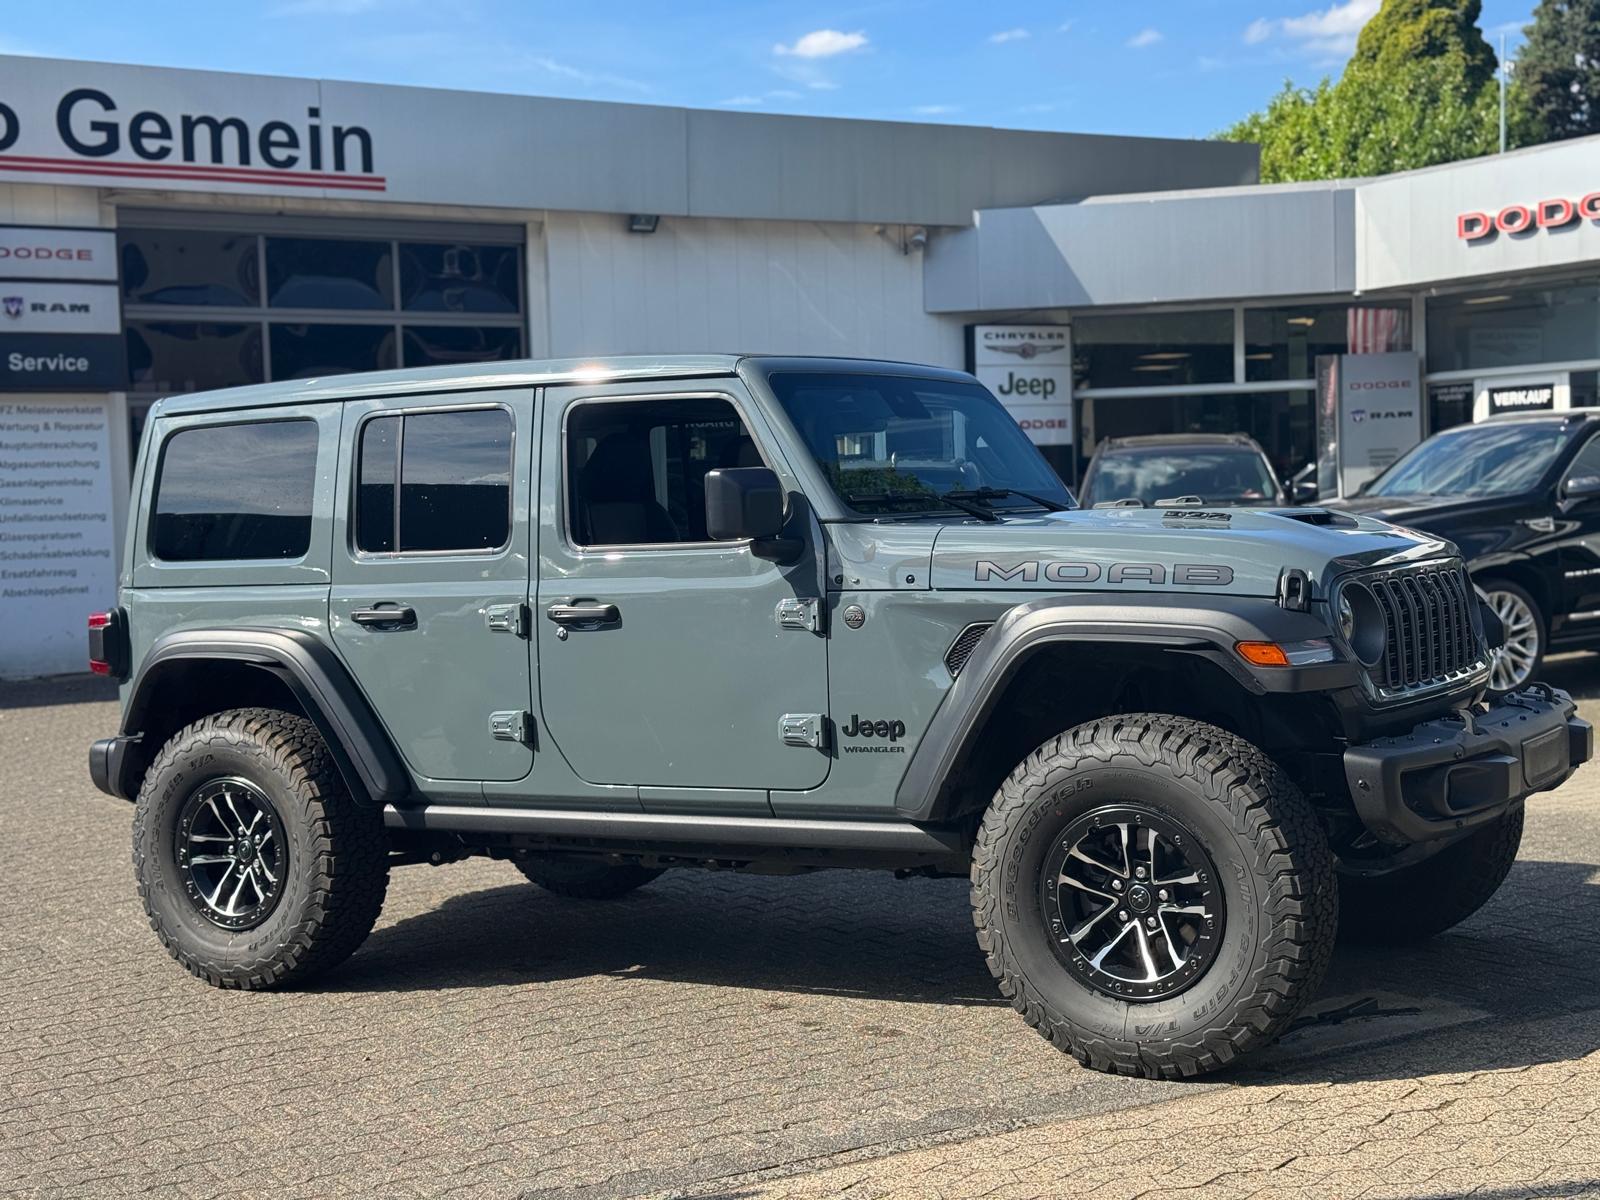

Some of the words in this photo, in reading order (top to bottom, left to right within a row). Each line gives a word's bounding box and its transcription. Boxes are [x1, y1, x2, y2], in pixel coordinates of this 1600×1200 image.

[56, 87, 374, 173] Gemein
[30, 302, 91, 314] RAM
[983, 331, 1065, 340] CHRYSLER
[8, 353, 89, 371] Service
[998, 371, 1055, 400] Jeep
[1350, 380, 1410, 390] DODGE
[1493, 388, 1551, 407] VERKAUF
[1370, 411, 1413, 419] RAM
[43, 421, 51, 432] &
[54, 422, 104, 433] Reparatur
[1020, 418, 1068, 430] ODGE
[0, 440, 98, 451] auptuntersuchung
[1, 567, 77, 580] Ersatzfahrzeug
[974, 560, 1235, 586] MOAB
[2, 586, 89, 599] Abschleppdienst
[842, 714, 906, 742] Jeep
[1005, 776, 1094, 922] BFGoodrich
